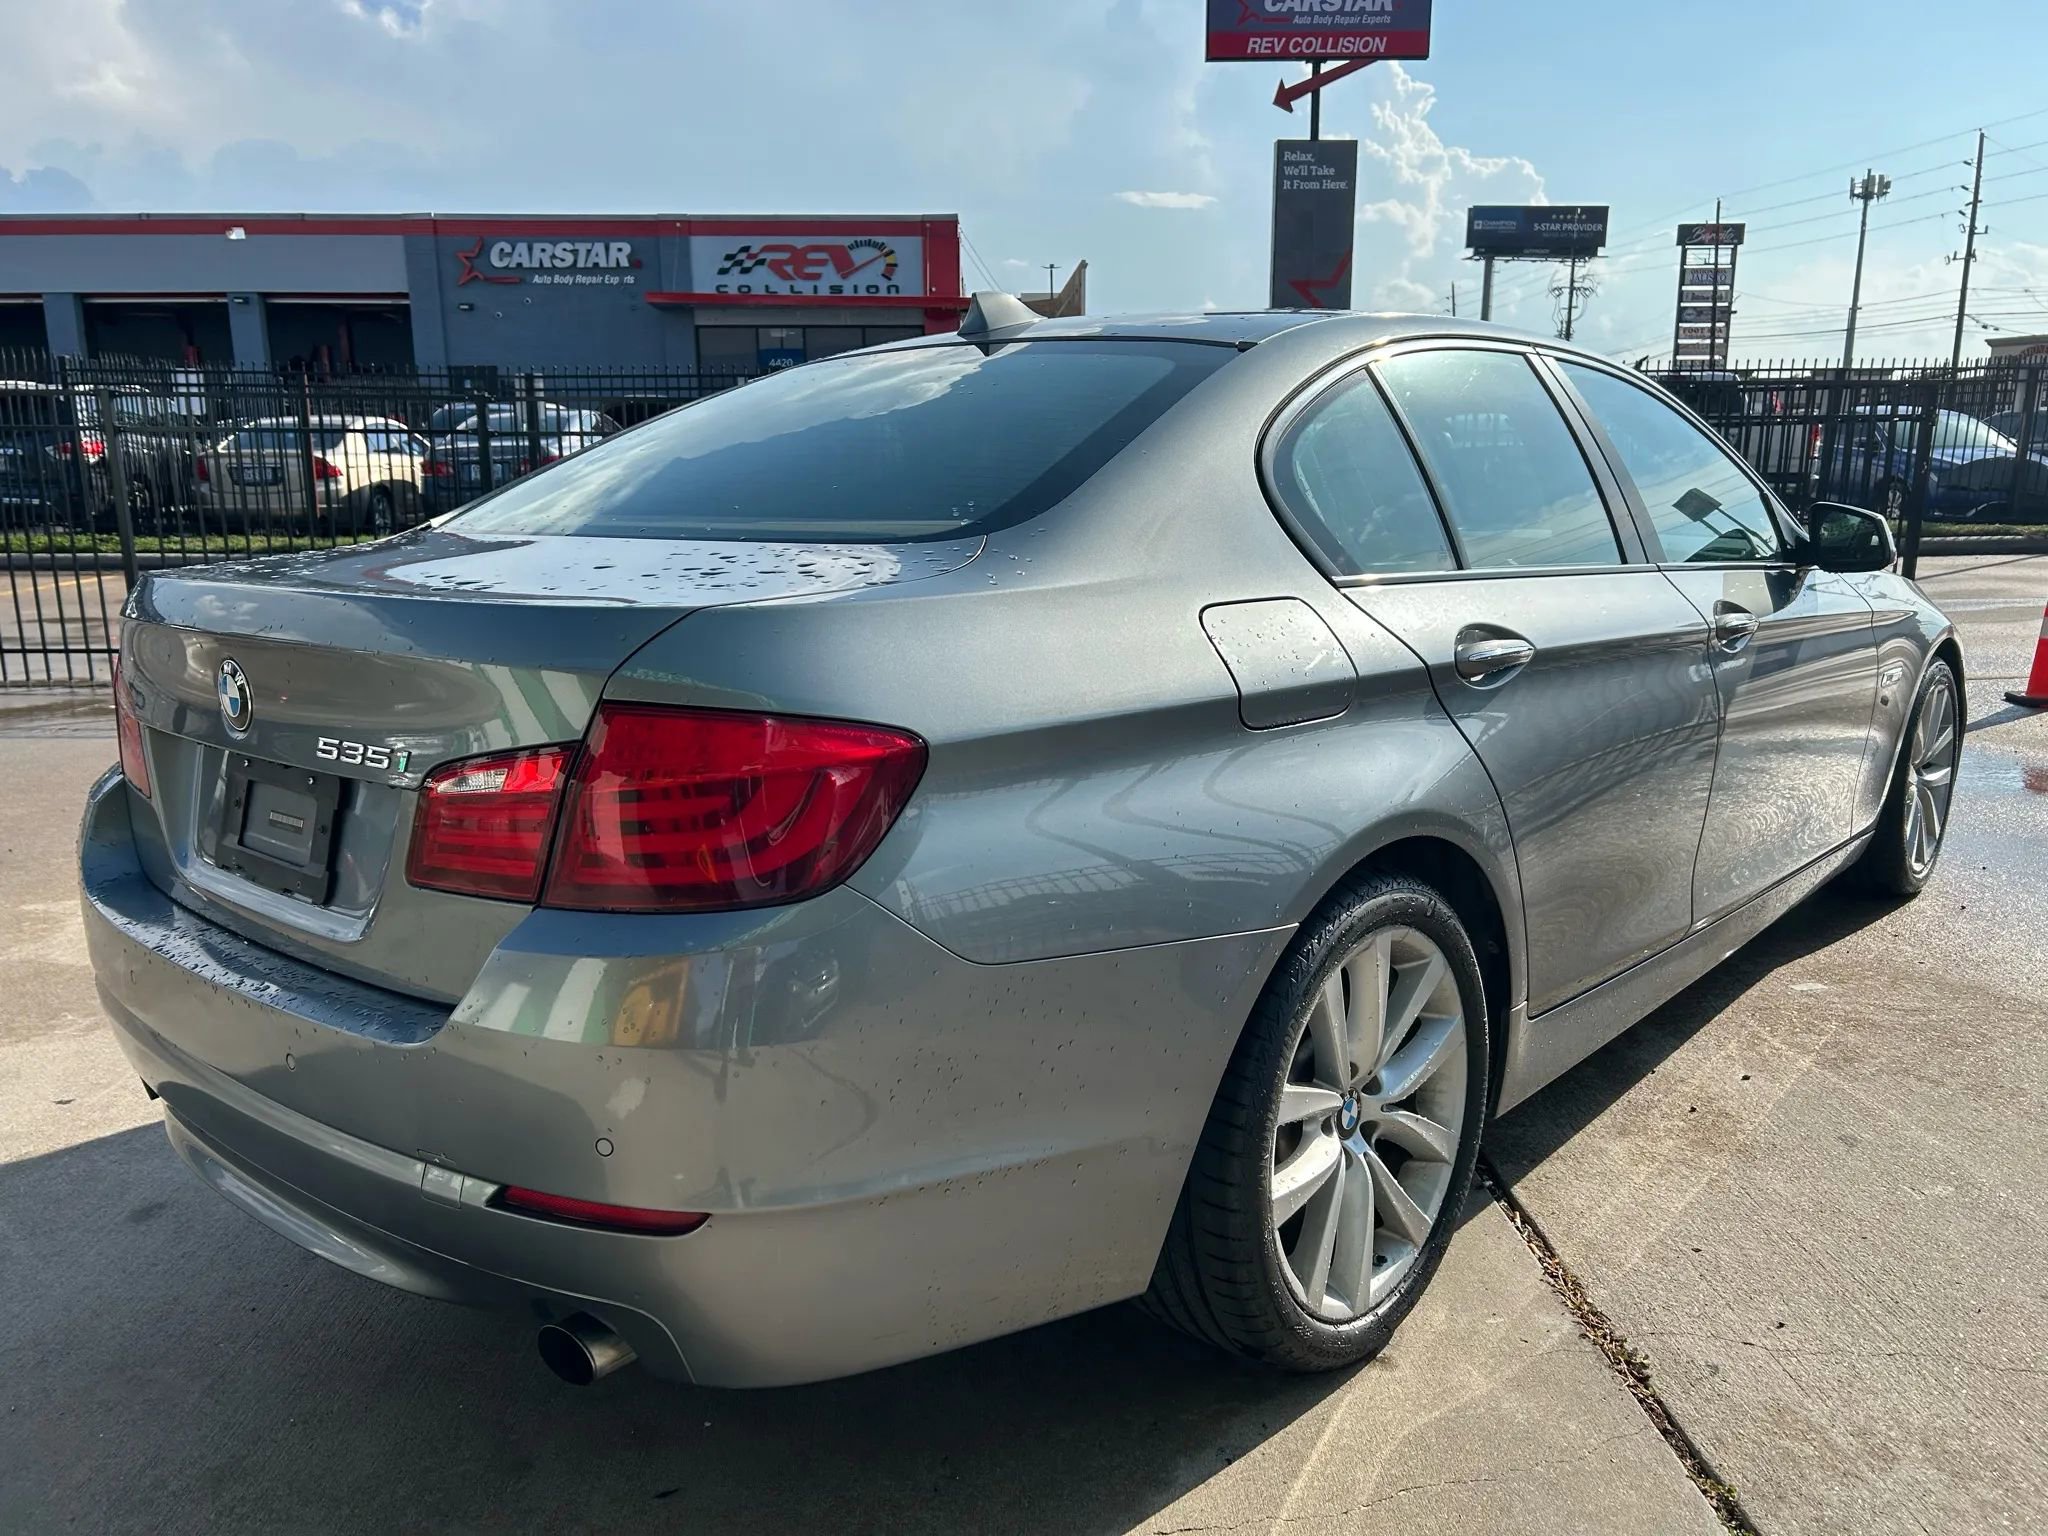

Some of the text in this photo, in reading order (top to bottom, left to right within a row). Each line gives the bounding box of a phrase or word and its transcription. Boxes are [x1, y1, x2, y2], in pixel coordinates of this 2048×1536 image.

[1293, 14, 1391, 26] Auto Body Repair Experts
[1247, 37, 1388, 54] REV COLLISION
[1283, 150, 1315, 163] Relax,
[1309, 165, 1336, 176] Take
[1283, 179, 1291, 190] It
[1293, 179, 1320, 190] From
[1562, 223, 1603, 232] PROVIDER
[489, 241, 632, 269] CARSTAR
[757, 244, 882, 282] REV
[532, 274, 551, 285] Auto
[553, 274, 574, 286] Body
[575, 273, 603, 286] Repair
[768, 358, 794, 368] 4420
[316, 735, 412, 773] 535i
